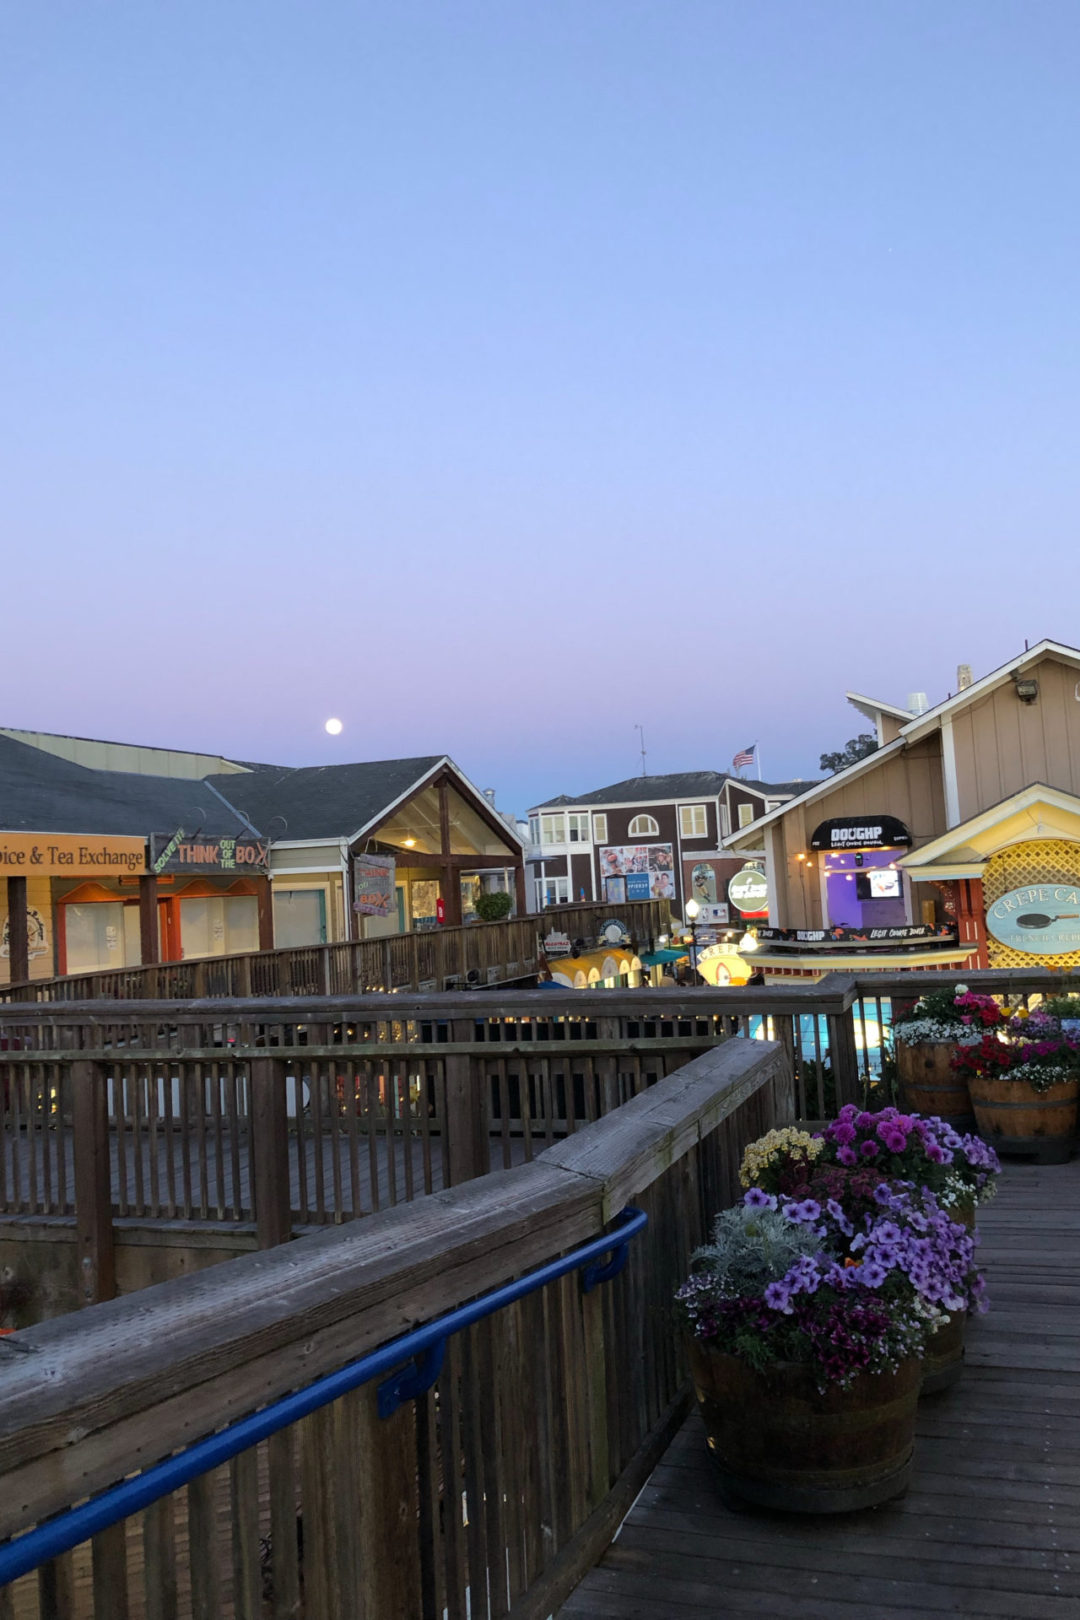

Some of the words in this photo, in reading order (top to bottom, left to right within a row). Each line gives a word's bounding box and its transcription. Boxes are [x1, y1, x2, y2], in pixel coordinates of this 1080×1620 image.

[831, 826, 882, 841] DOUGHP
[178, 844, 219, 864] THINK
[220, 839, 236, 849] OUT
[0, 846, 25, 865] ice
[30, 846, 43, 865] &
[47, 846, 74, 865] Tea
[78, 846, 143, 871] Exchange
[154, 843, 177, 873] SOLVE
[221, 859, 236, 869] THE
[222, 850, 233, 859] OF
[235, 841, 269, 868] BOX
[994, 888, 1049, 919] CREPE
